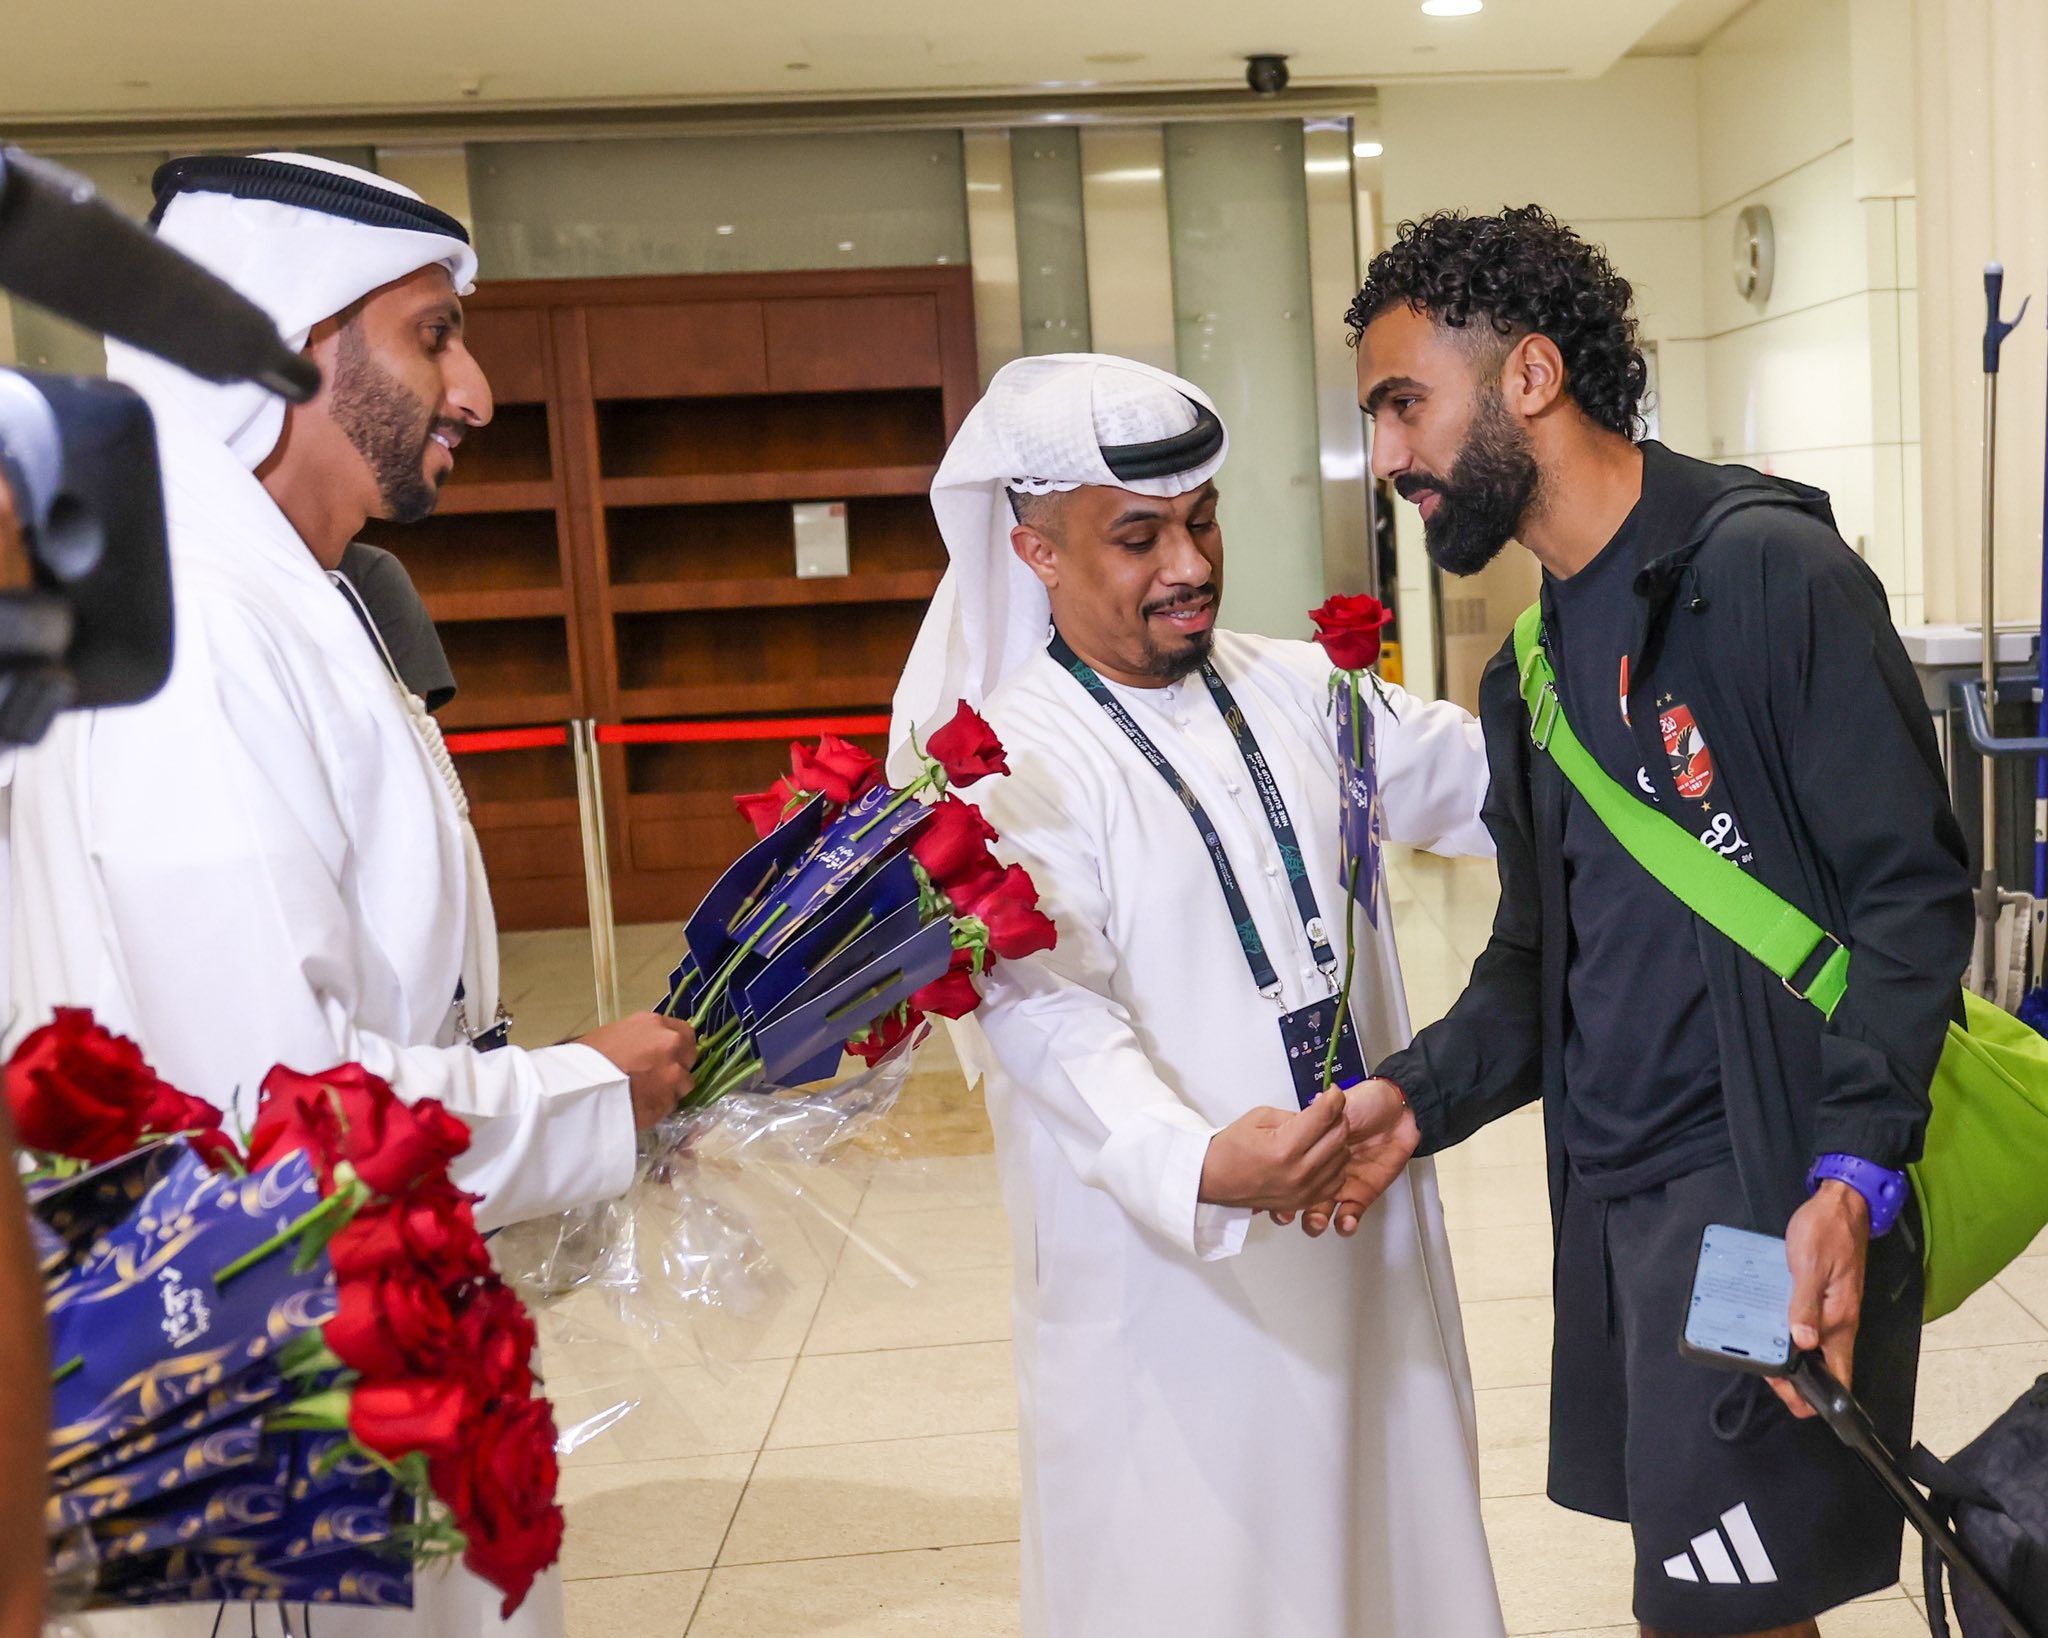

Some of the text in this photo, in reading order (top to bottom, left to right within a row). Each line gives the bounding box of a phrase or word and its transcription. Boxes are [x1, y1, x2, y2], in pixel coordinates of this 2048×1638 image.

[1114, 716, 1135, 738] SUPER
[1253, 751, 1289, 827] NBE SUPER CUP 2025
